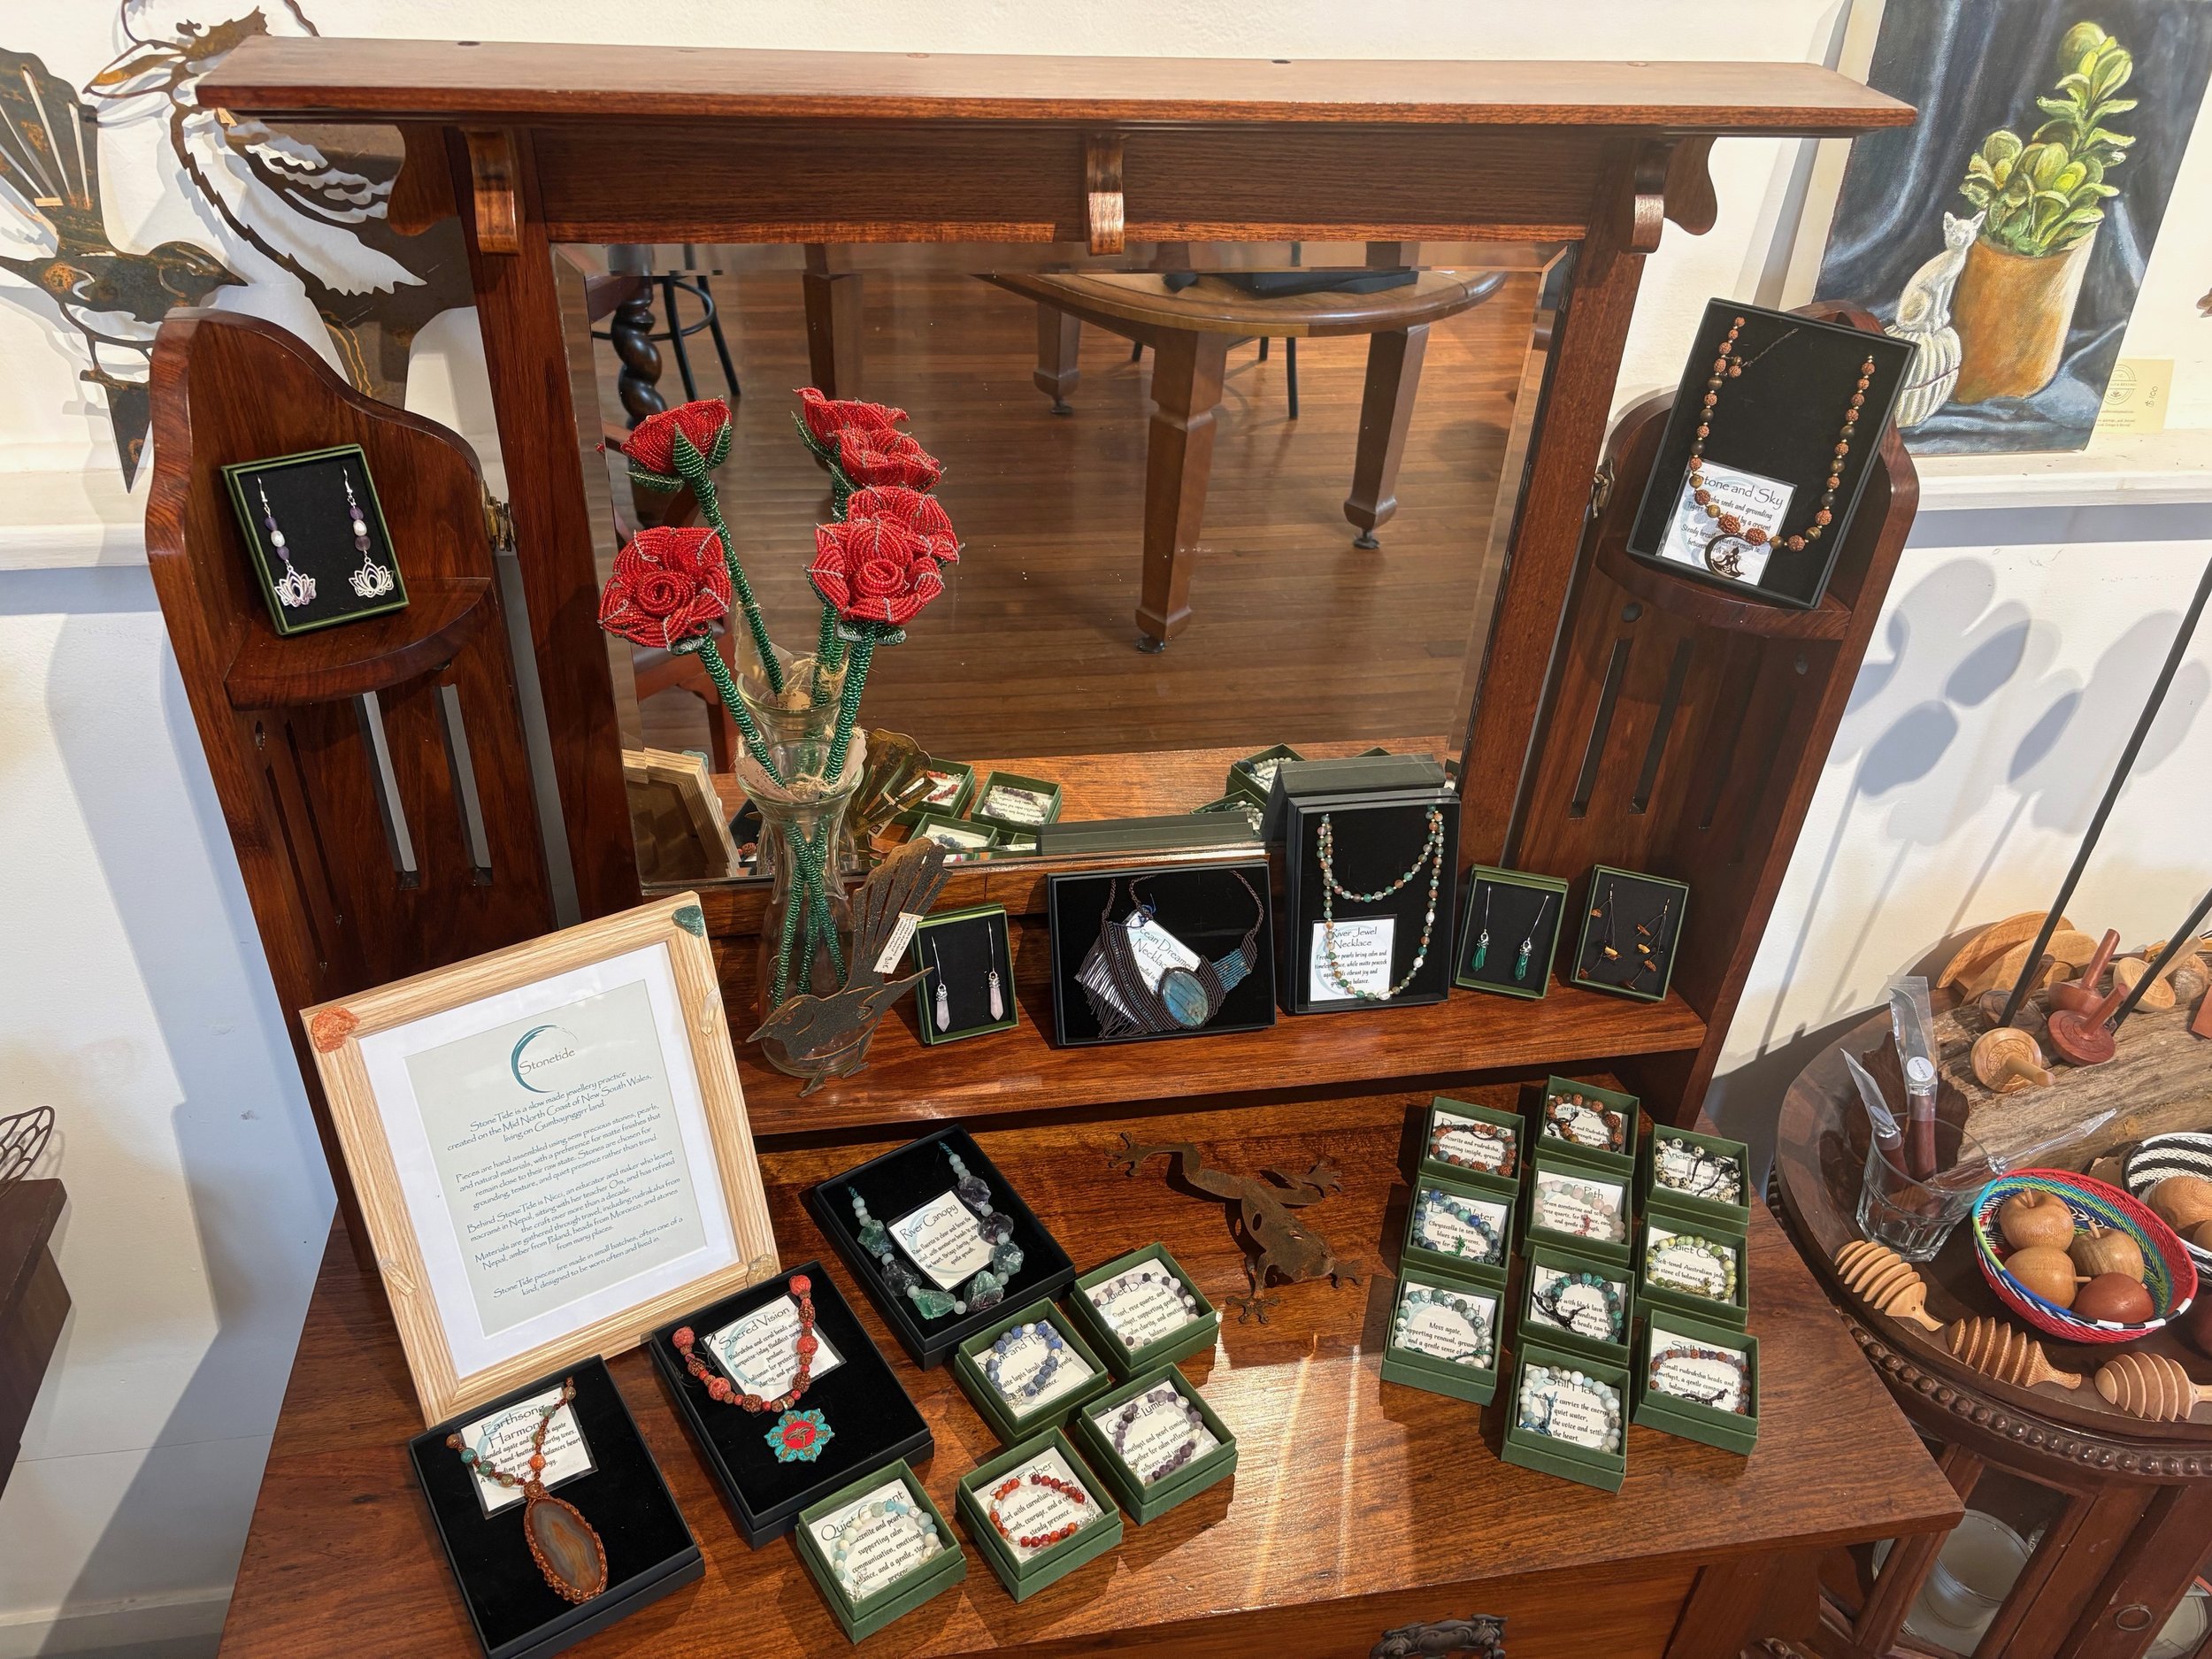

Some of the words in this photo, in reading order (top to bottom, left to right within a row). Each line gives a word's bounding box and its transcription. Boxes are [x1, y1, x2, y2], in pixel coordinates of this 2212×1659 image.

[1732, 482, 1755, 497] and
[1755, 488, 1783, 510] Sky
[1721, 499, 1733, 509] seeds
[1735, 502, 1746, 511] and
[1746, 507, 1772, 520] grounding
[1353, 926, 1377, 938] Jewel
[1133, 939, 1167, 969] Necklac
[1158, 939, 1194, 970] Dreamer
[1333, 940, 1371, 949] Necklace
[518, 1048, 575, 1076] Stonetide
[527, 1101, 544, 1110] slow
[545, 1091, 565, 1103] made
[563, 1082, 596, 1100] jewellery
[597, 1071, 626, 1088] practice
[447, 1133, 476, 1150] created
[488, 1126, 502, 1135] the
[502, 1118, 519, 1132] Mid
[519, 1109, 545, 1125] North
[546, 1097, 571, 1116] Coast
[572, 1095, 580, 1106] of
[580, 1087, 599, 1103] New
[598, 1080, 626, 1096] South
[455, 1170, 480, 1183] Pieces
[492, 1155, 511, 1168] hand
[512, 1141, 548, 1161] assembled
[548, 1138, 567, 1148] using
[582, 1122, 611, 1138] precious
[611, 1113, 636, 1125] stones,
[503, 1132, 524, 1142] living
[1474, 1143, 1500, 1153] rudraksha,
[459, 1179, 473, 1191] and
[473, 1170, 499, 1186] natural
[533, 1153, 547, 1164] with
[553, 1135, 590, 1159] preference
[602, 1128, 620, 1138] matte
[621, 1116, 646, 1131] finishes
[647, 1112, 660, 1122] that
[472, 1191, 511, 1210] grounding,
[511, 1181, 538, 1194] texture,
[539, 1172, 552, 1184] and
[552, 1168, 570, 1180] quiet
[570, 1156, 601, 1174] presence
[601, 1148, 622, 1159] rather
[622, 1142, 638, 1152] than
[475, 1185, 498, 1196] remain
[498, 1178, 517, 1187] close
[526, 1167, 542, 1177] their
[577, 1145, 604, 1159] Stones
[617, 1132, 641, 1143] chosen
[466, 1215, 495, 1233] Behind
[574, 1176, 604, 1191] educator
[606, 1168, 618, 1179] and
[619, 1163, 639, 1173] maker
[653, 1149, 672, 1160] learnt
[900, 1223, 923, 1240] River
[923, 1203, 958, 1226] Canopy
[950, 1255, 963, 1265] gentle
[962, 1248, 976, 1260] growth.
[1681, 1272, 1701, 1283] balance,
[1684, 1264, 1712, 1275] Australian
[1129, 1303, 1140, 1312] rose
[1140, 1295, 1156, 1307] quartz,
[1156, 1288, 1166, 1297] and
[1138, 1303, 1163, 1319] supporting
[1163, 1296, 1177, 1310] gentle
[719, 1318, 758, 1350] Sacred
[757, 1307, 790, 1328] Vision
[1429, 1322, 1444, 1332] Moss
[1445, 1326, 1462, 1336] agate,
[766, 1348, 786, 1363] pendant.
[1010, 1340, 1027, 1356] and
[1424, 1341, 1440, 1350] gentle
[749, 1367, 769, 1382] talisman
[1013, 1369, 1026, 1385] lapis
[1025, 1360, 1041, 1374] lazuli
[1662, 1363, 1678, 1371] Small
[1679, 1368, 1706, 1379] rudraksha
[1708, 1374, 1722, 1384] beads
[481, 1404, 545, 1437] Earthsong
[1554, 1409, 1568, 1417] quiet
[1570, 1412, 1588, 1422] water,
[1562, 1421, 1576, 1430] voice
[1577, 1424, 1588, 1432] and
[481, 1448, 502, 1462] Banded
[503, 1442, 519, 1454] agate
[519, 1437, 530, 1447] and
[552, 1422, 566, 1434] agate
[1146, 1434, 1155, 1444] and
[1156, 1426, 1168, 1440] pearl
[1168, 1417, 1187, 1432] coming
[1563, 1430, 1579, 1442] heart.
[1014, 1502, 1025, 1517] with
[1026, 1493, 1052, 1511] carnelian,
[1029, 1522, 1048, 1537] steady
[1048, 1509, 1071, 1528] presence.
[852, 1548, 895, 1573] communication,
[895, 1531, 923, 1549] emotional
[857, 1533, 893, 1556] supporting
[892, 1527, 903, 1541] calm
